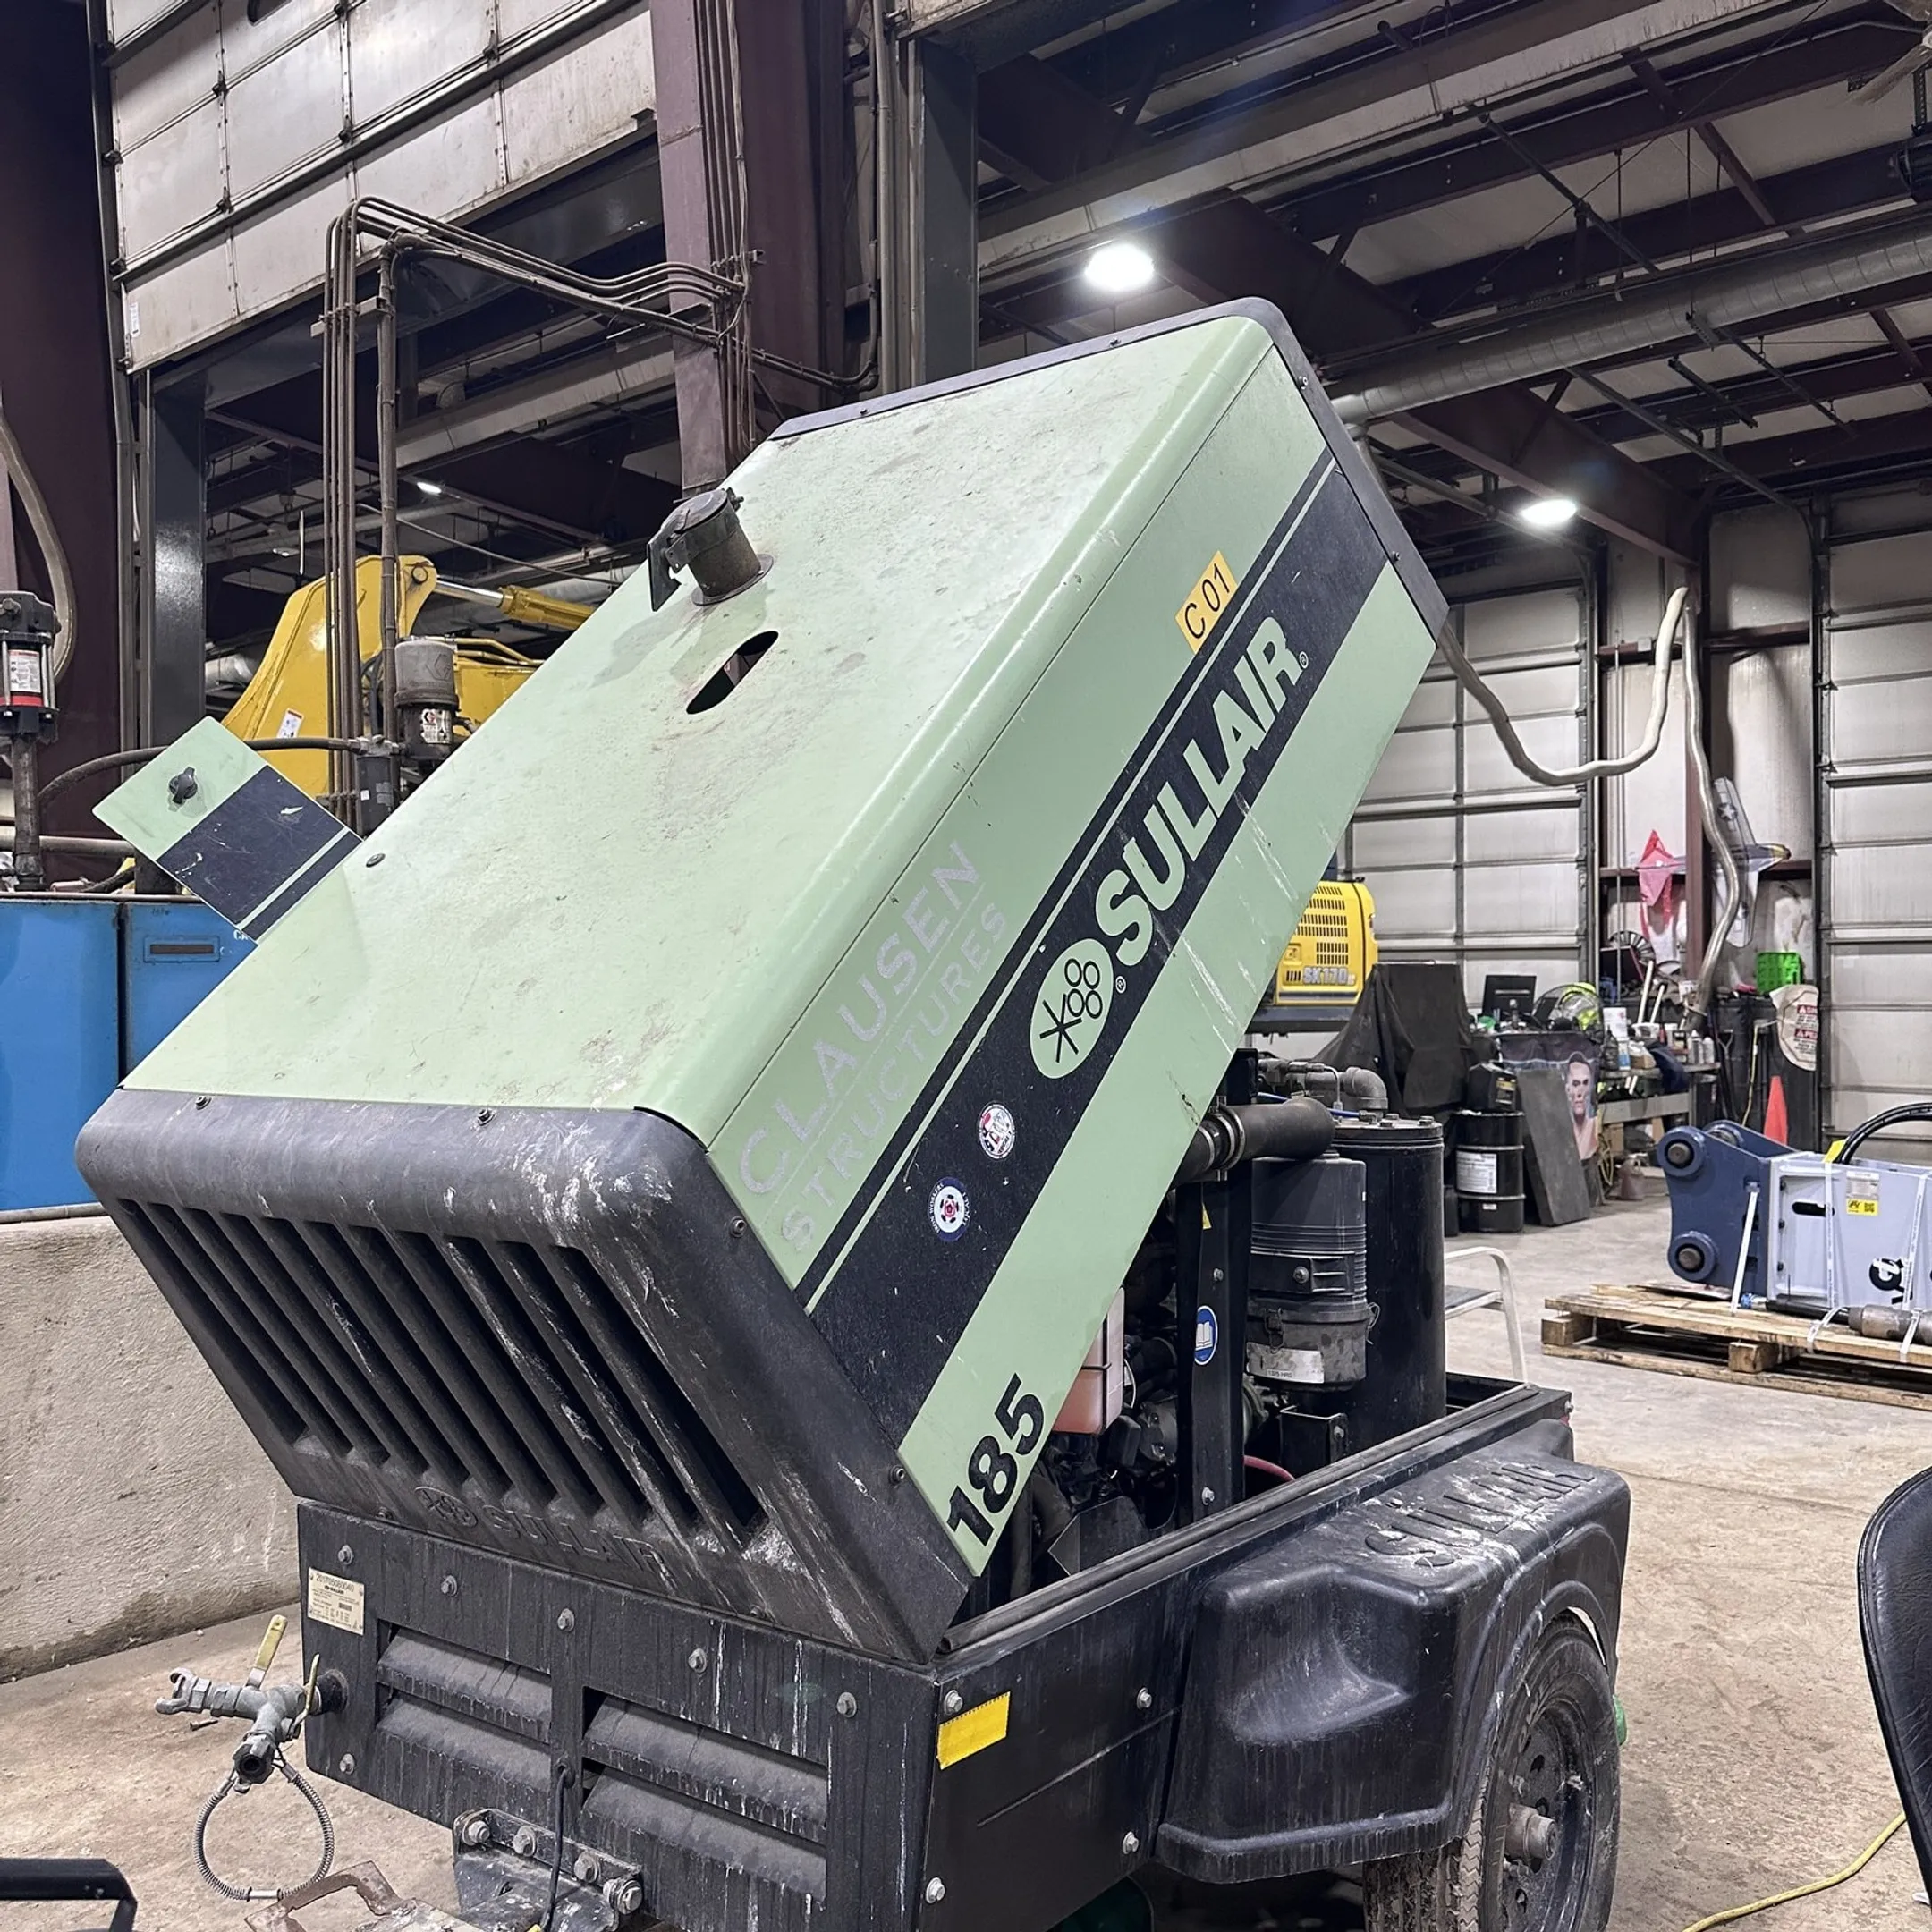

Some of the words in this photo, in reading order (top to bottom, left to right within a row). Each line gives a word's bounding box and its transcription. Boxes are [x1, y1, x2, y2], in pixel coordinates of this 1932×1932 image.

[1184, 602, 1206, 639] C
[1201, 563, 1230, 612] 01
[1096, 616, 1303, 966] SULLAIR
[740, 839, 979, 1194] CLAUSEN
[782, 902, 1006, 1251] STRUCTURES
[482, 1504, 678, 1590] SULLAIR
[946, 1372, 1045, 1547] 185
[1364, 1462, 1596, 1567] SULLAIR
